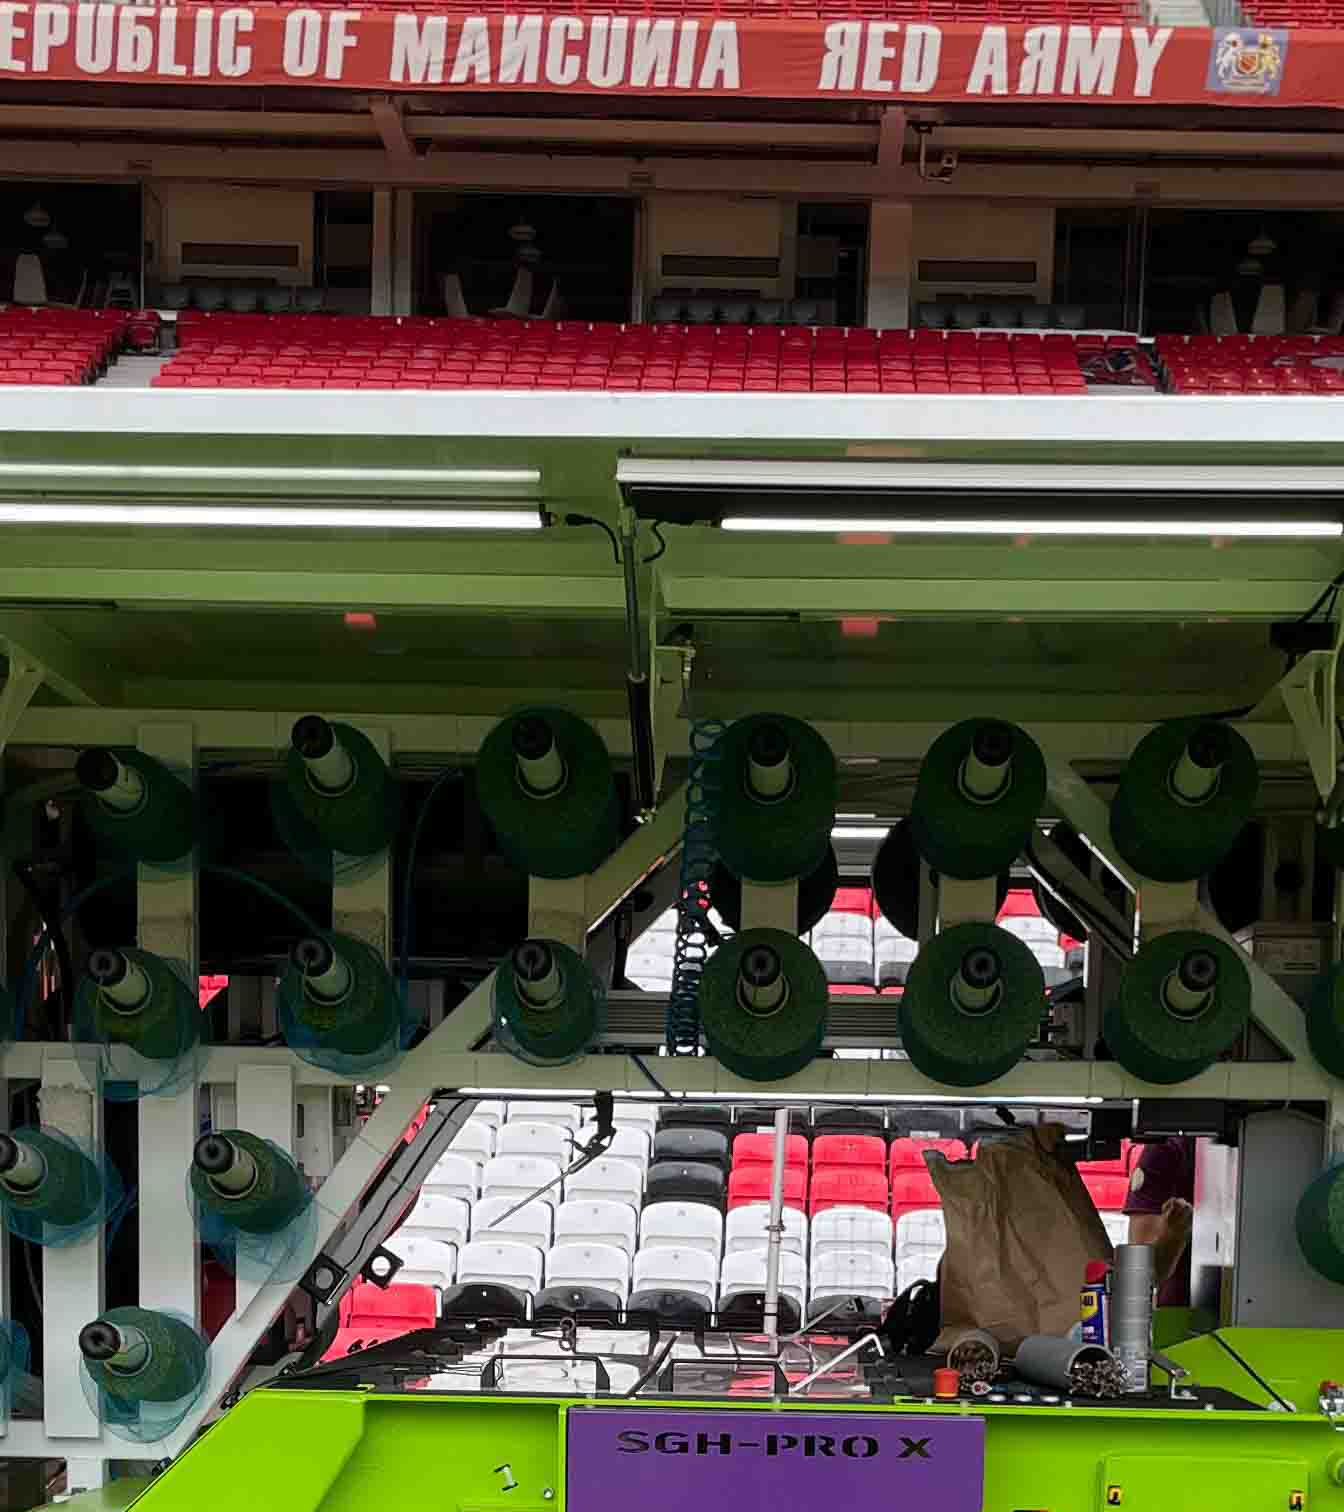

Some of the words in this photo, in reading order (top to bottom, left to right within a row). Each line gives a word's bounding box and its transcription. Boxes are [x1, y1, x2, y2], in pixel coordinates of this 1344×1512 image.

[282, 8, 360, 79] OF
[616, 1430, 880, 1459] SGH-PRO
[895, 1436, 934, 1459] X
